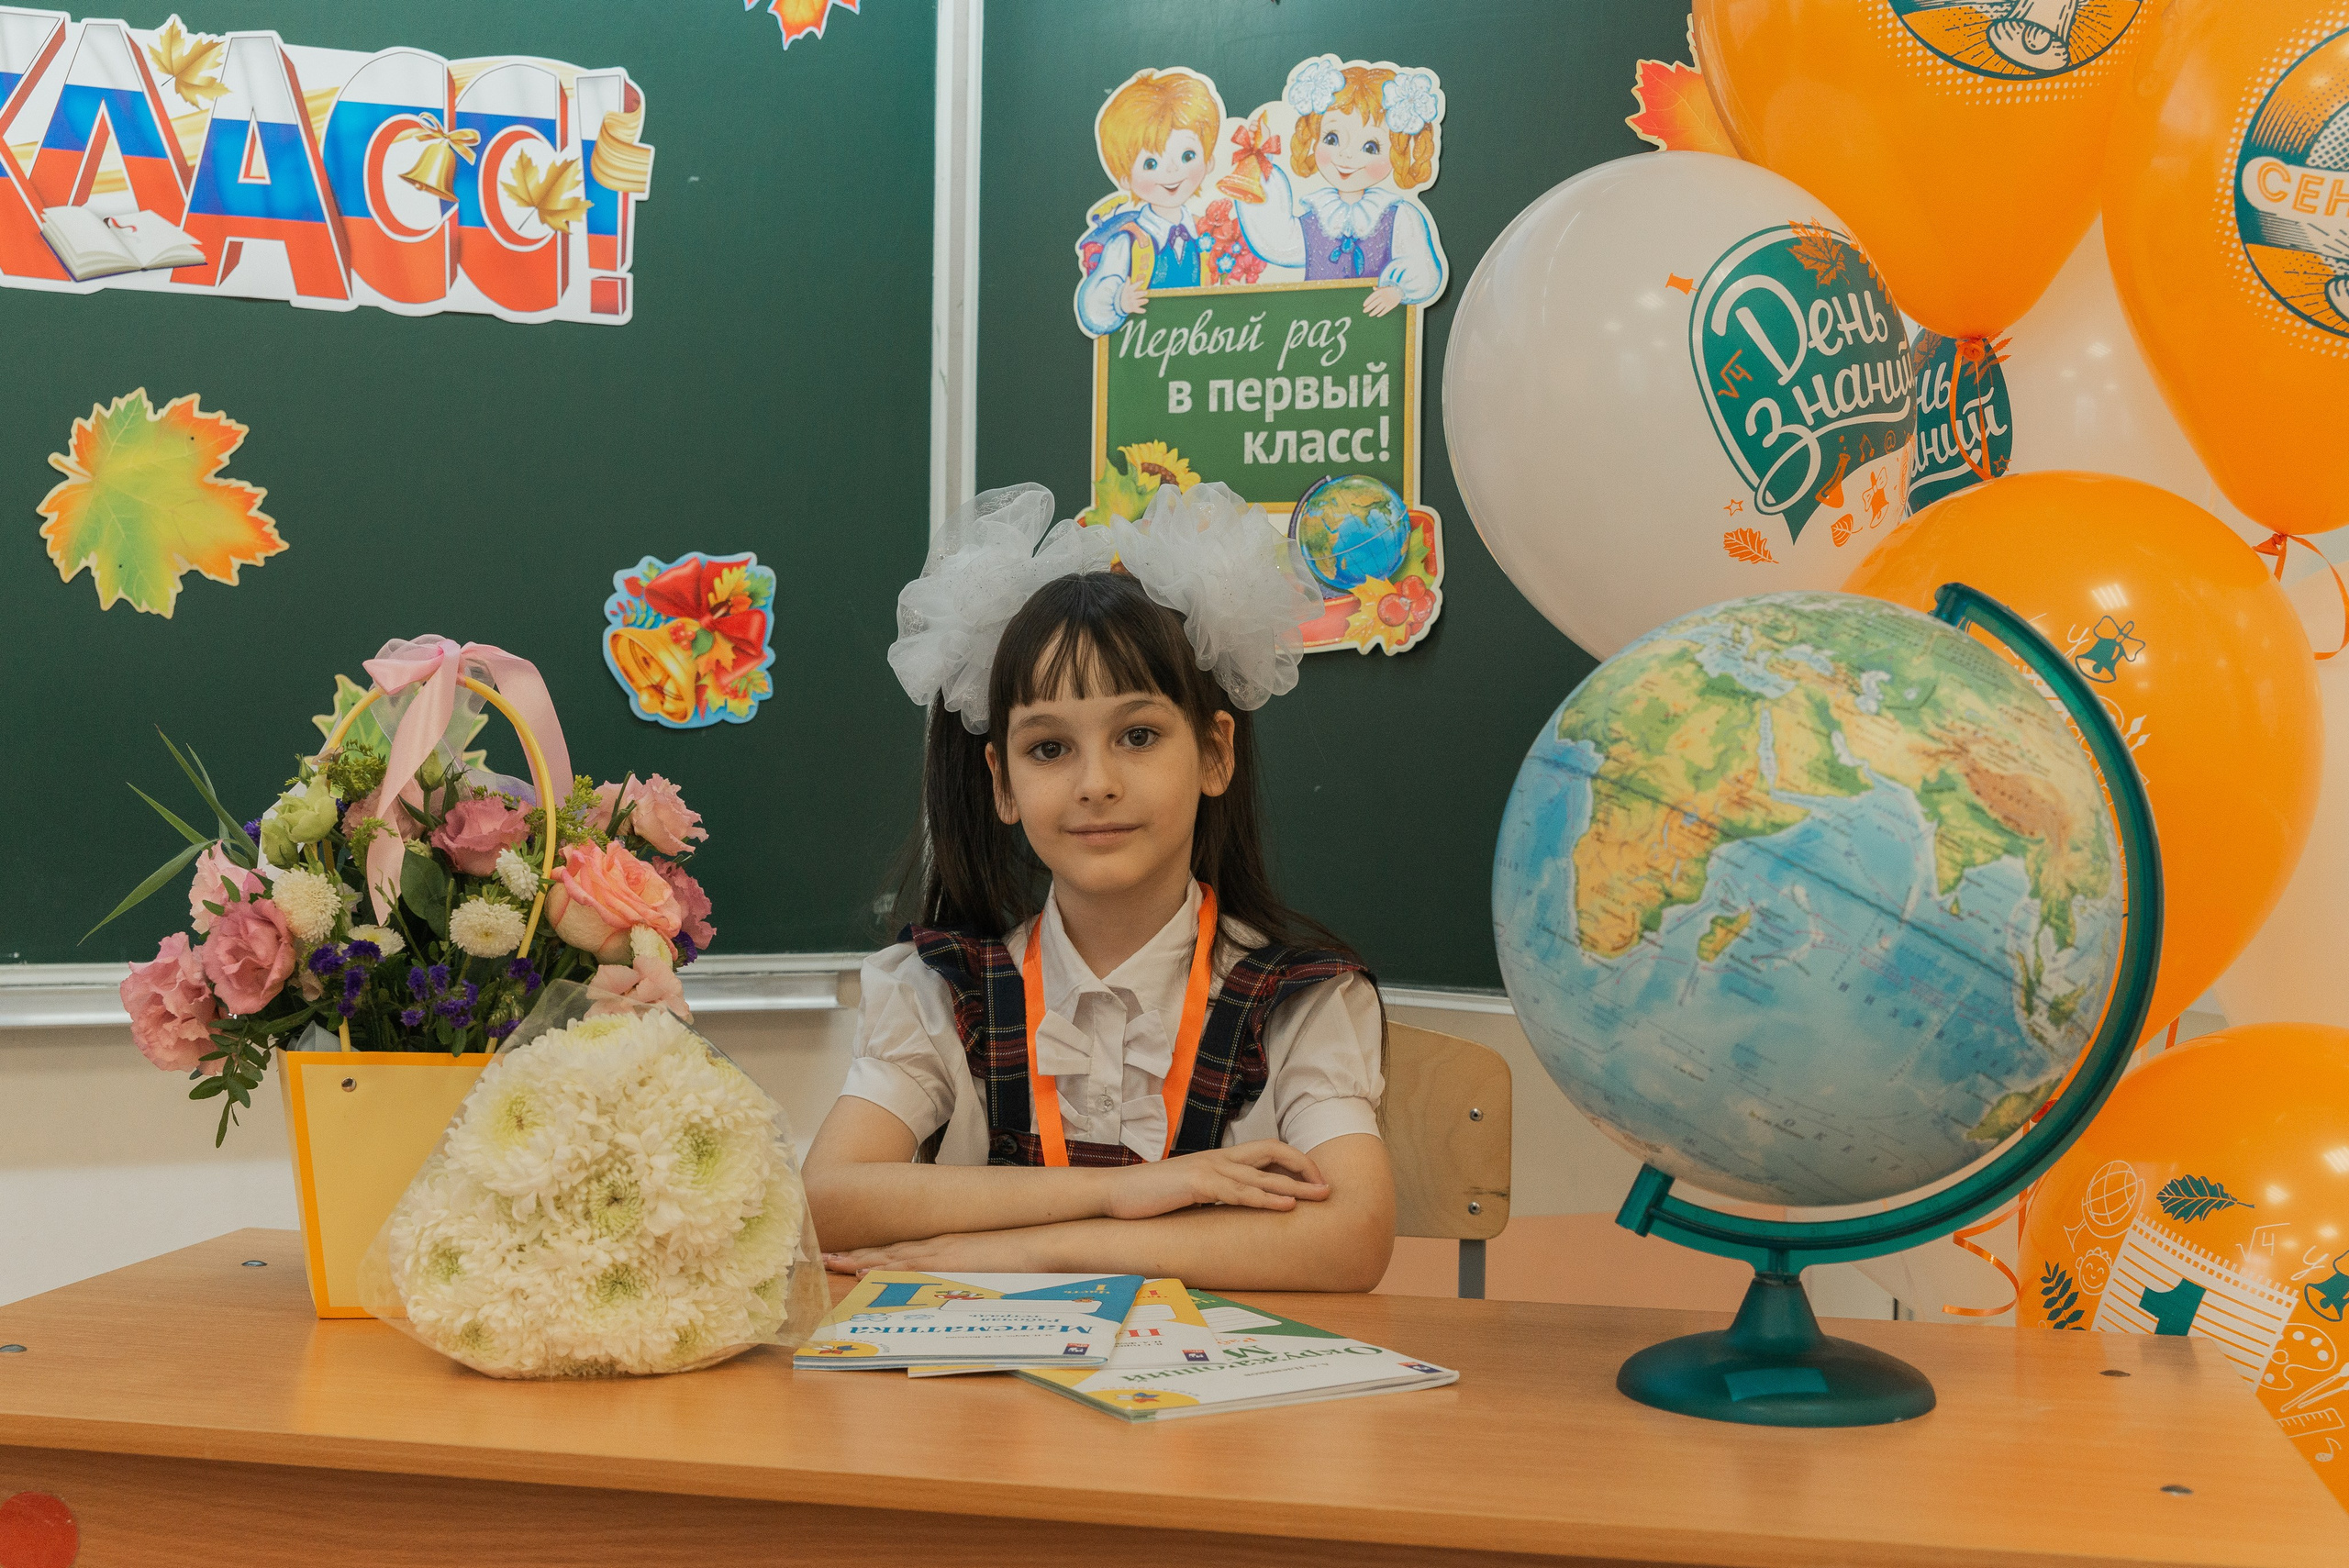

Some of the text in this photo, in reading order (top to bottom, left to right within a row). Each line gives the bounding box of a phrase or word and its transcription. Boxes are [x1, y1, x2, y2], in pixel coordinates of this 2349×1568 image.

[1119, 310, 1353, 378] Первый раз
[1710, 274, 1888, 385] День
[1167, 361, 1389, 422] в первый
[1243, 416, 1390, 464] класс!
[850, 1325, 1093, 1335] Математика
